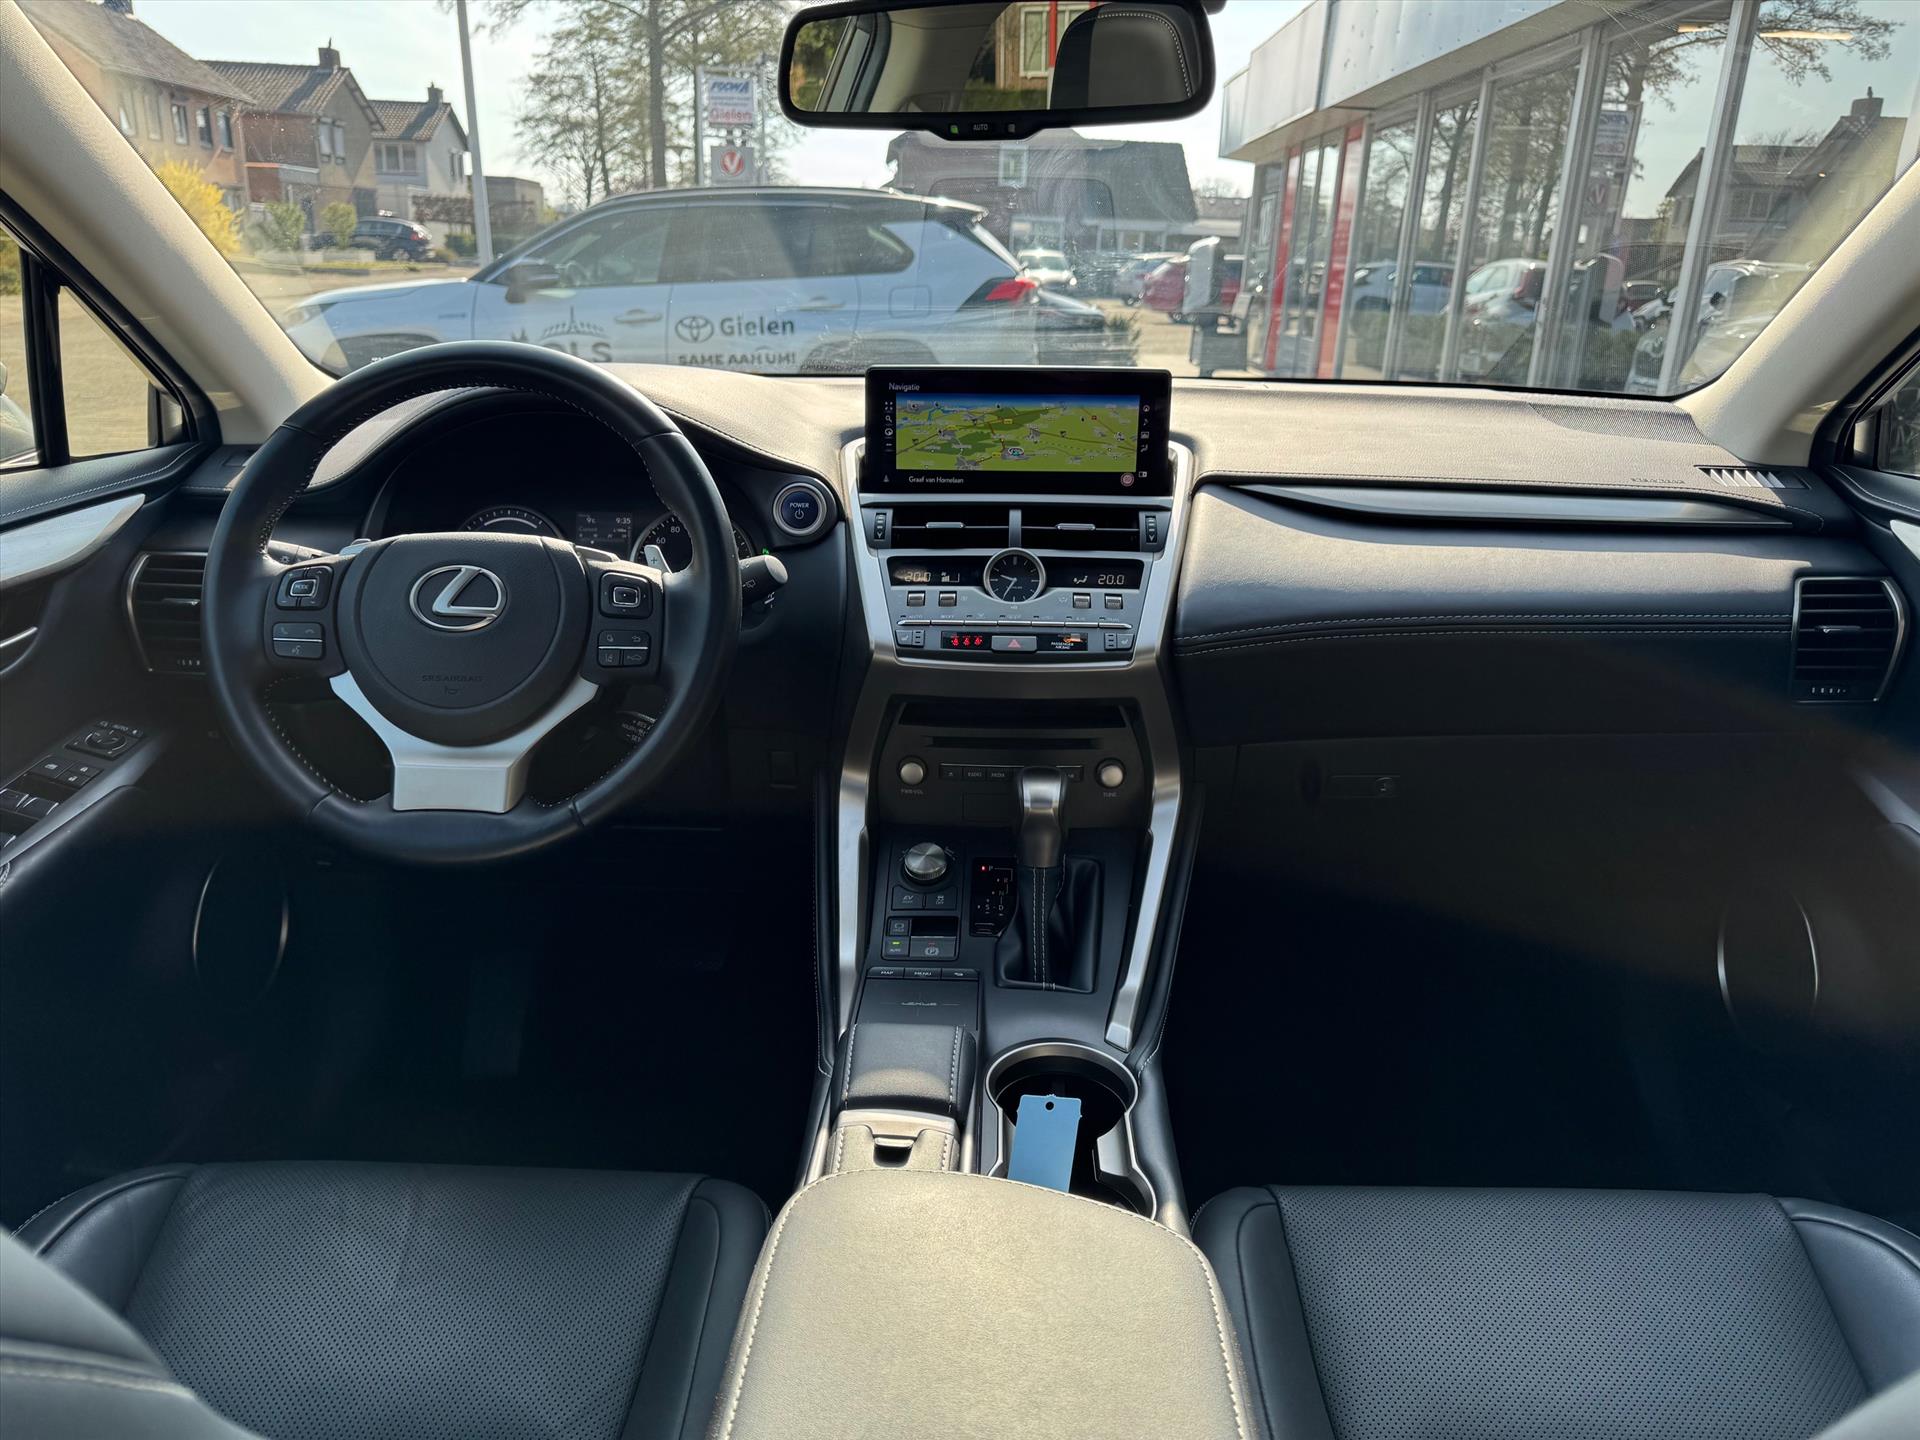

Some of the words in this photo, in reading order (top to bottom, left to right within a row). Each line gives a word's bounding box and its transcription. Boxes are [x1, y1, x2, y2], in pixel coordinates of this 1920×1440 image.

[973, 123, 988, 131] AUTO
[720, 316, 795, 336] Gielen
[888, 382, 921, 392] Navigatie
[908, 475, 925, 484] Graaf
[615, 517, 631, 525] 9:35
[656, 536, 666, 544] 60
[1097, 574, 1125, 585] 20.0
